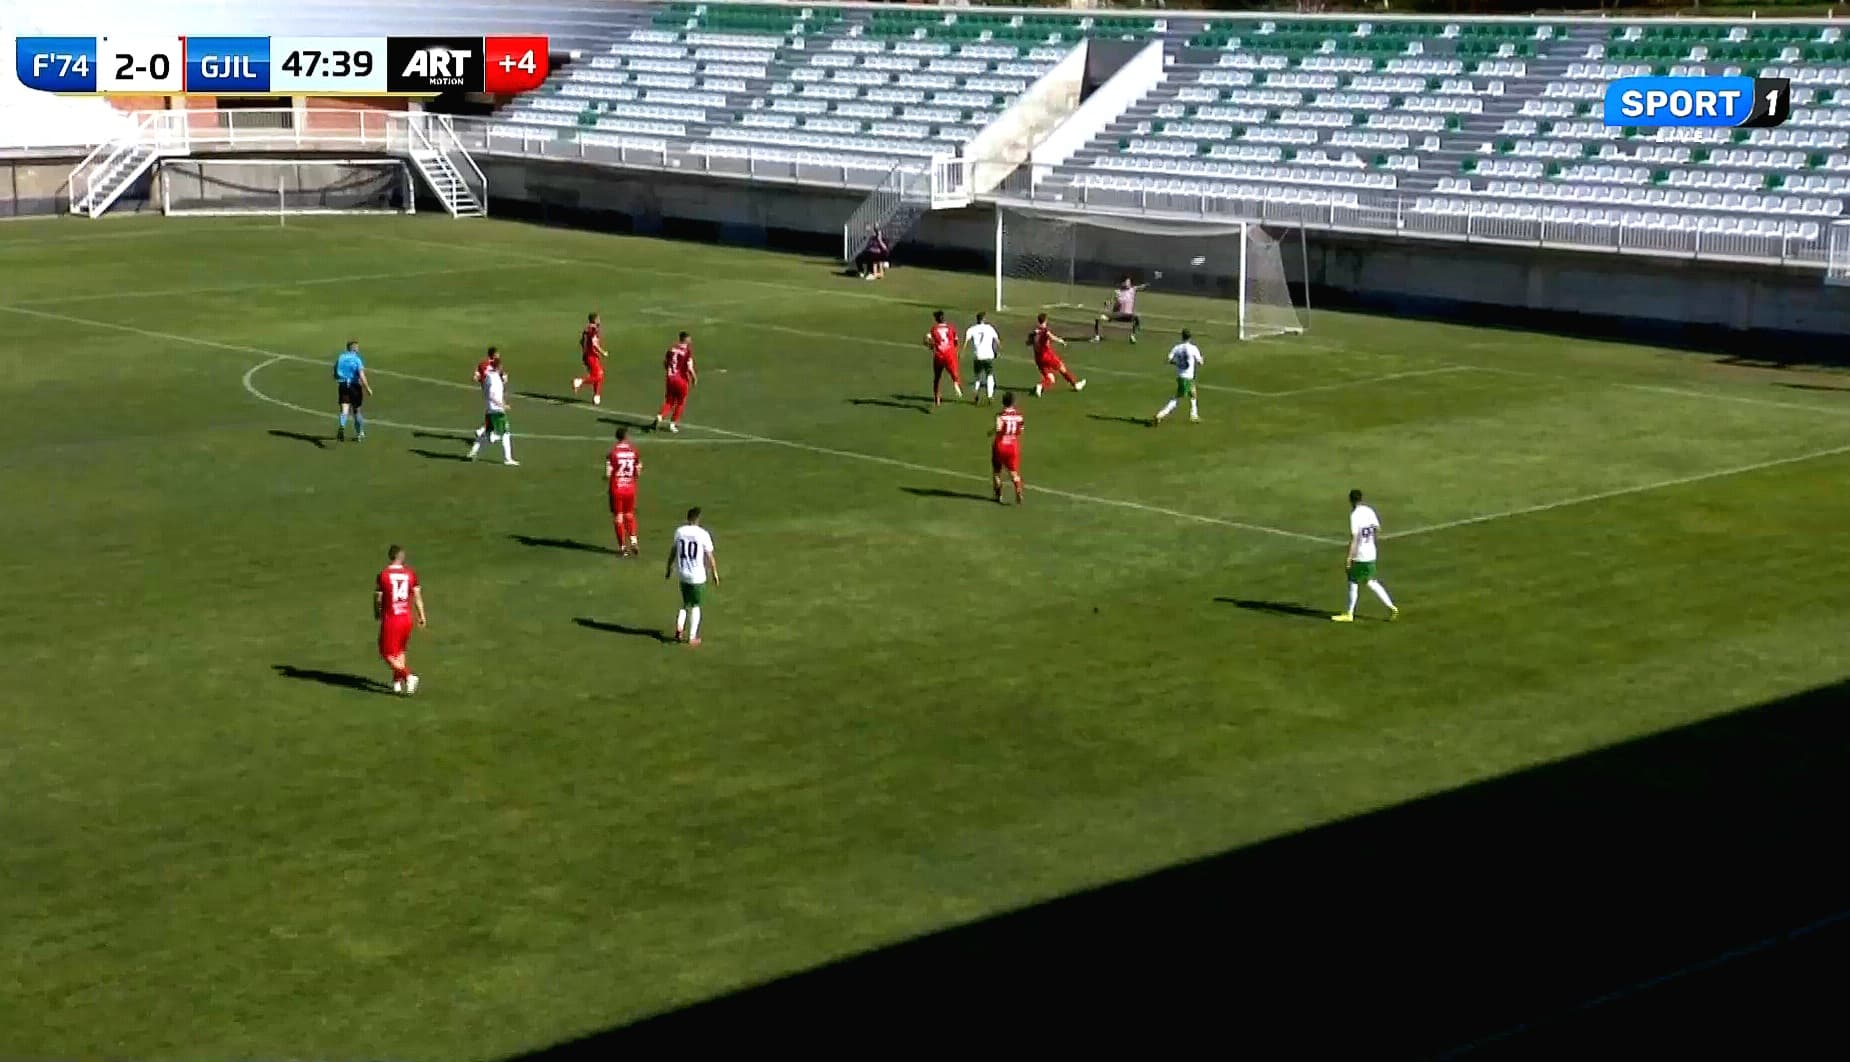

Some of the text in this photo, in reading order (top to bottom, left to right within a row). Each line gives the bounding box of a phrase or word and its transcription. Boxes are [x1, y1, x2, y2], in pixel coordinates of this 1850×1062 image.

[978, 331, 985, 344] 7
[679, 538, 698, 559] 10
[392, 578, 408, 601] 14
